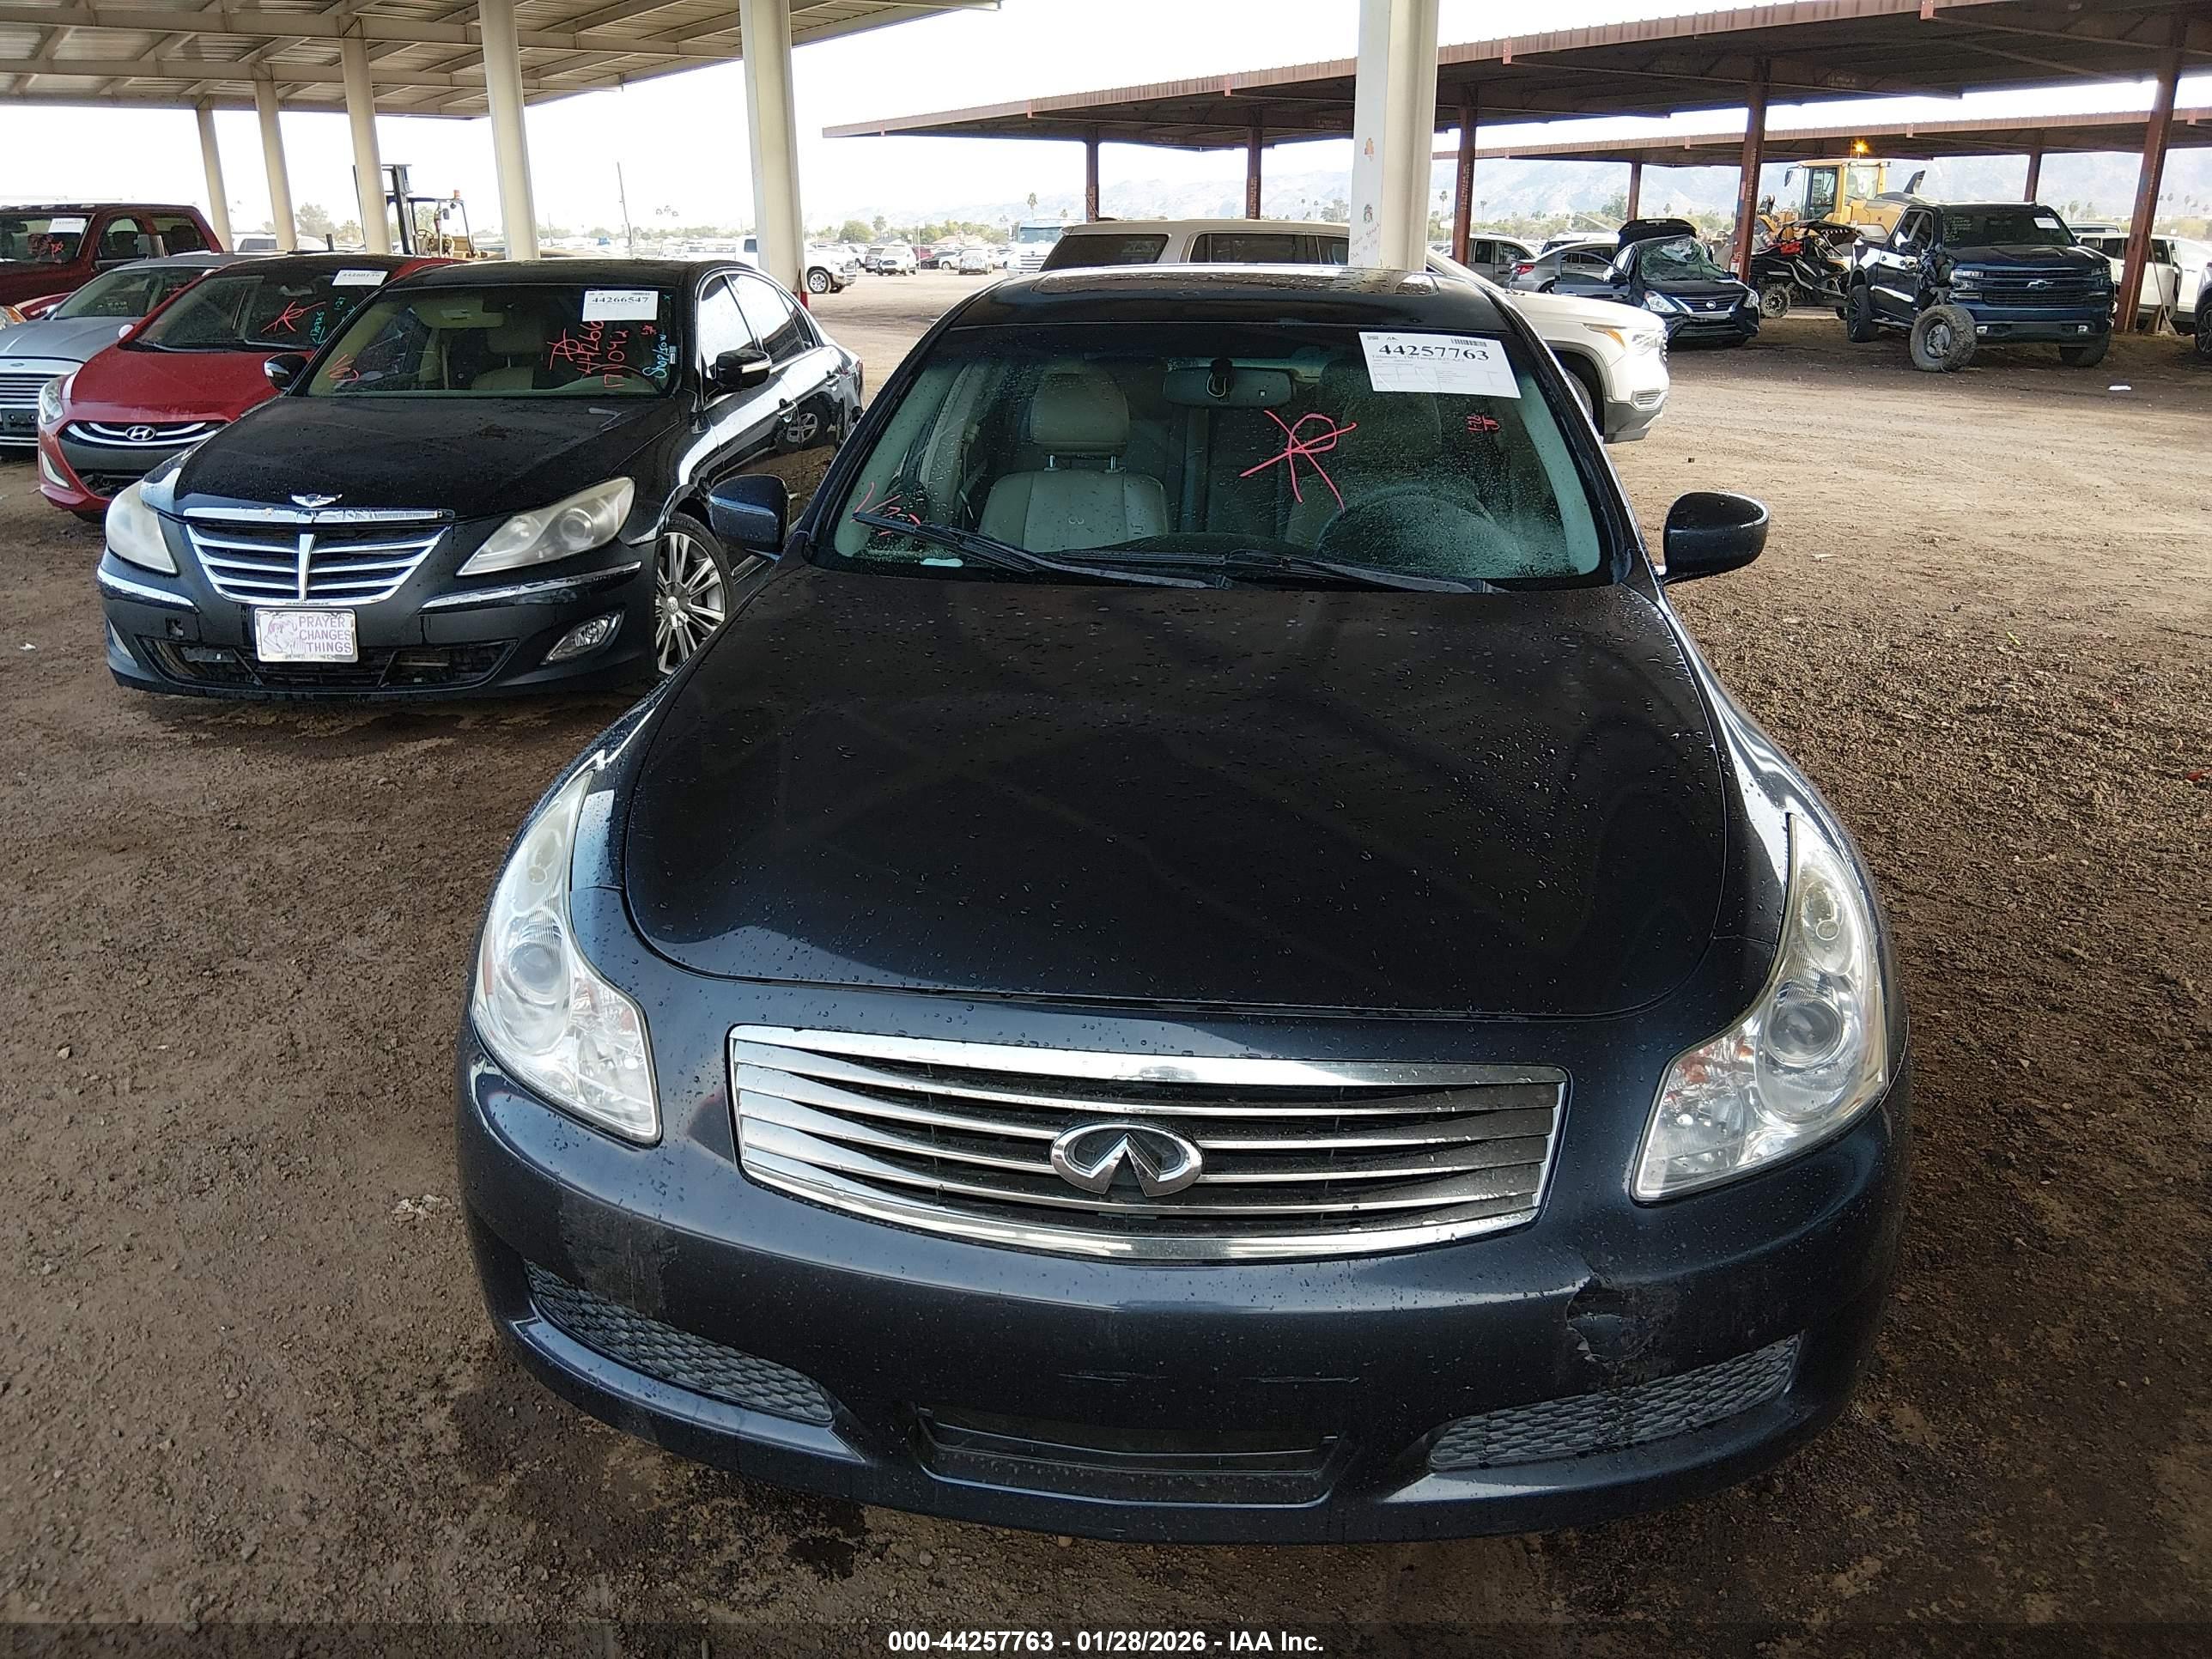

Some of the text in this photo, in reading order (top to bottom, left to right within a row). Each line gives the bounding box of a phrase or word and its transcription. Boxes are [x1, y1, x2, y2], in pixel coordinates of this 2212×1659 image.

[1379, 343, 1490, 361] 44257763
[299, 616, 345, 628] PRAYER
[299, 629, 352, 641] CHANGES
[306, 641, 352, 653] THINGS
